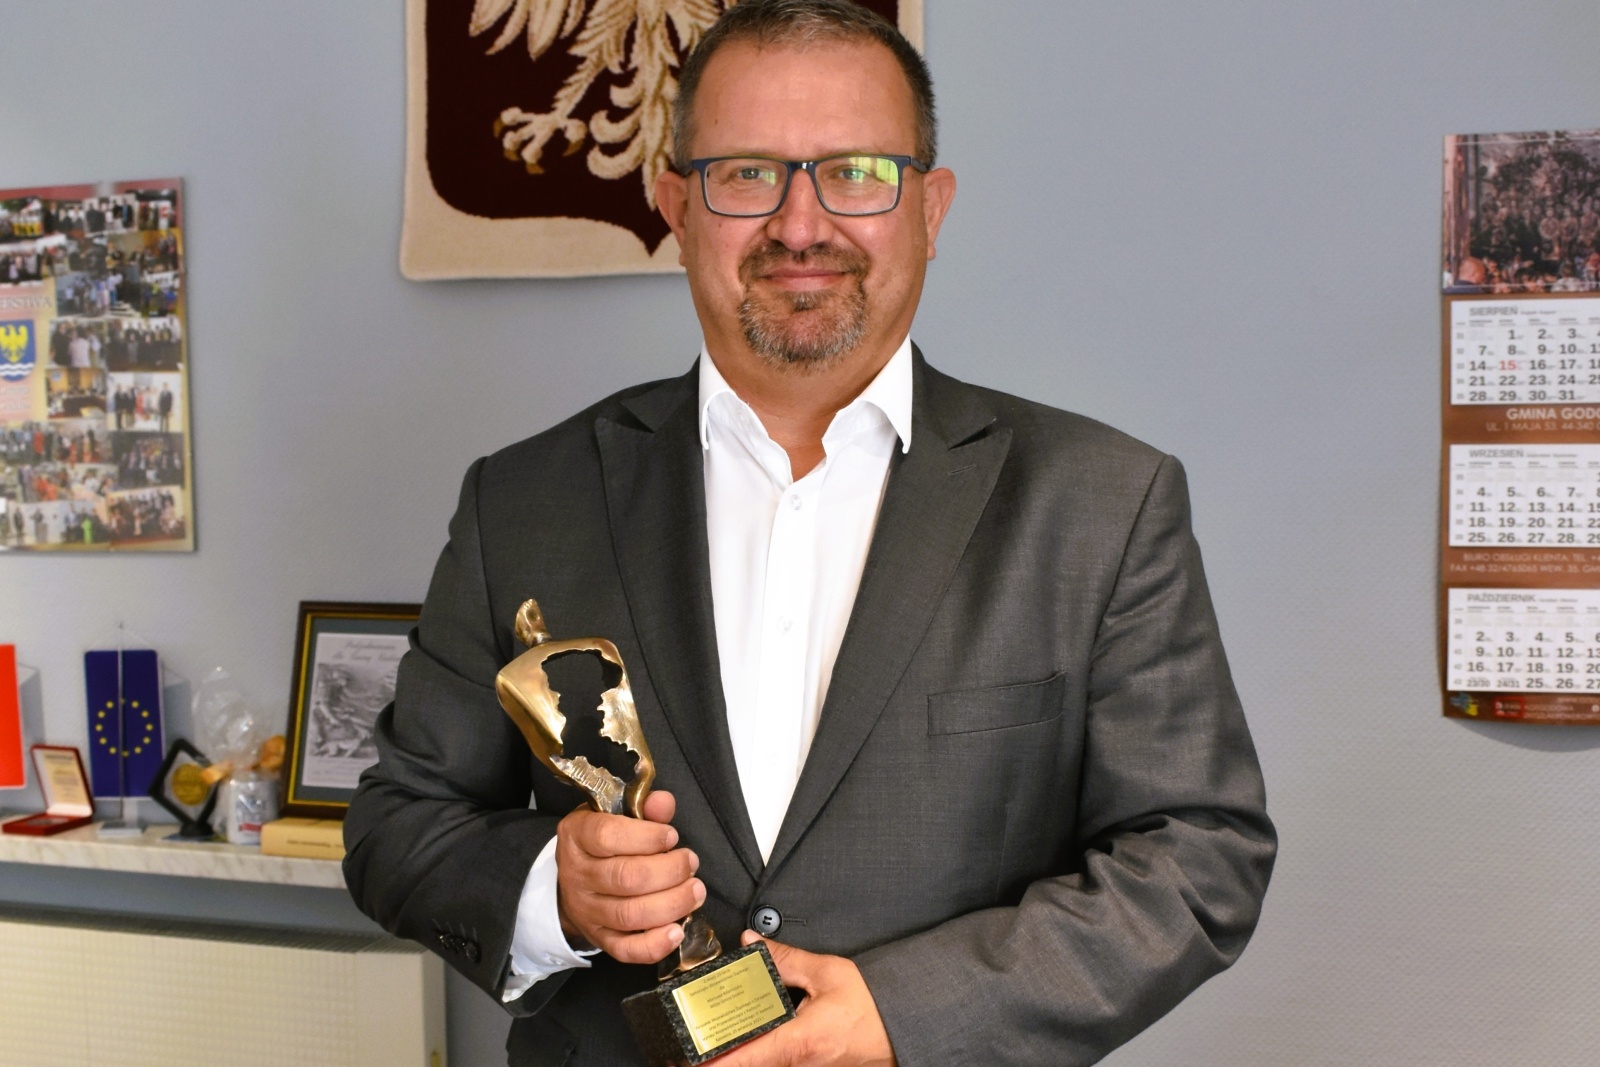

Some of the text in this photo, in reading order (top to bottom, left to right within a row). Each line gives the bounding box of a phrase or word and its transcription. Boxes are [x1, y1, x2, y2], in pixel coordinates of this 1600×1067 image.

[1470, 306, 1518, 316] SIERPIEŃ
[1509, 328, 1577, 340] 1 2 3
[1479, 345, 1487, 355] 7
[1508, 345, 1517, 355] 8
[1538, 344, 1547, 354] 9
[1560, 344, 1577, 354] 10
[1470, 361, 1486, 371] 14
[1500, 360, 1517, 370] 15
[1530, 360, 1546, 370] 16
[1560, 359, 1576, 370] 17
[1470, 376, 1486, 386] 21
[1499, 376, 1516, 386] 22
[1529, 375, 1546, 385] 23
[1558, 375, 1576, 384] 24
[1470, 391, 1487, 401] 28
[1499, 391, 1516, 401] 29
[1529, 390, 1547, 401] 30
[1559, 390, 1576, 400] 31
[1506, 408, 1557, 420] GMINA
[1511, 422, 1541, 431] MAJA
[1469, 448, 1524, 458] WRZESIEŃ
[1477, 487, 1486, 496] 4
[1507, 487, 1516, 497] 5
[1537, 487, 1546, 497] 6
[1568, 487, 1575, 497] 7
[1470, 502, 1485, 512] 11
[1500, 502, 1515, 512] 12
[1529, 502, 1546, 512] 13
[1559, 503, 1574, 512] 14
[1470, 517, 1486, 527] 18
[1499, 517, 1516, 527] 19
[1528, 518, 1545, 528] 20
[1558, 518, 1574, 528] 21
[1468, 532, 1486, 542] 25
[1498, 533, 1515, 542] 26
[1528, 533, 1544, 543] 27
[1558, 533, 1575, 543] 28
[1468, 592, 1536, 602] PAŹDZIERNIK
[1476, 632, 1484, 641] 2
[1506, 632, 1514, 642] 3
[1535, 632, 1544, 642] 4
[1566, 632, 1574, 642] 5
[1476, 647, 1484, 656] 9
[1498, 647, 1514, 657] 10
[1528, 648, 1543, 658] 11
[1558, 648, 1573, 658] 12
[1468, 662, 1484, 672] 16
[1498, 662, 1514, 672] 17
[1528, 663, 1544, 673] 18
[1557, 663, 1574, 673] 19
[1467, 679, 1490, 687] 23/30
[1497, 680, 1519, 688] 24/31
[1526, 678, 1544, 688] 25
[1556, 678, 1574, 688] 26
